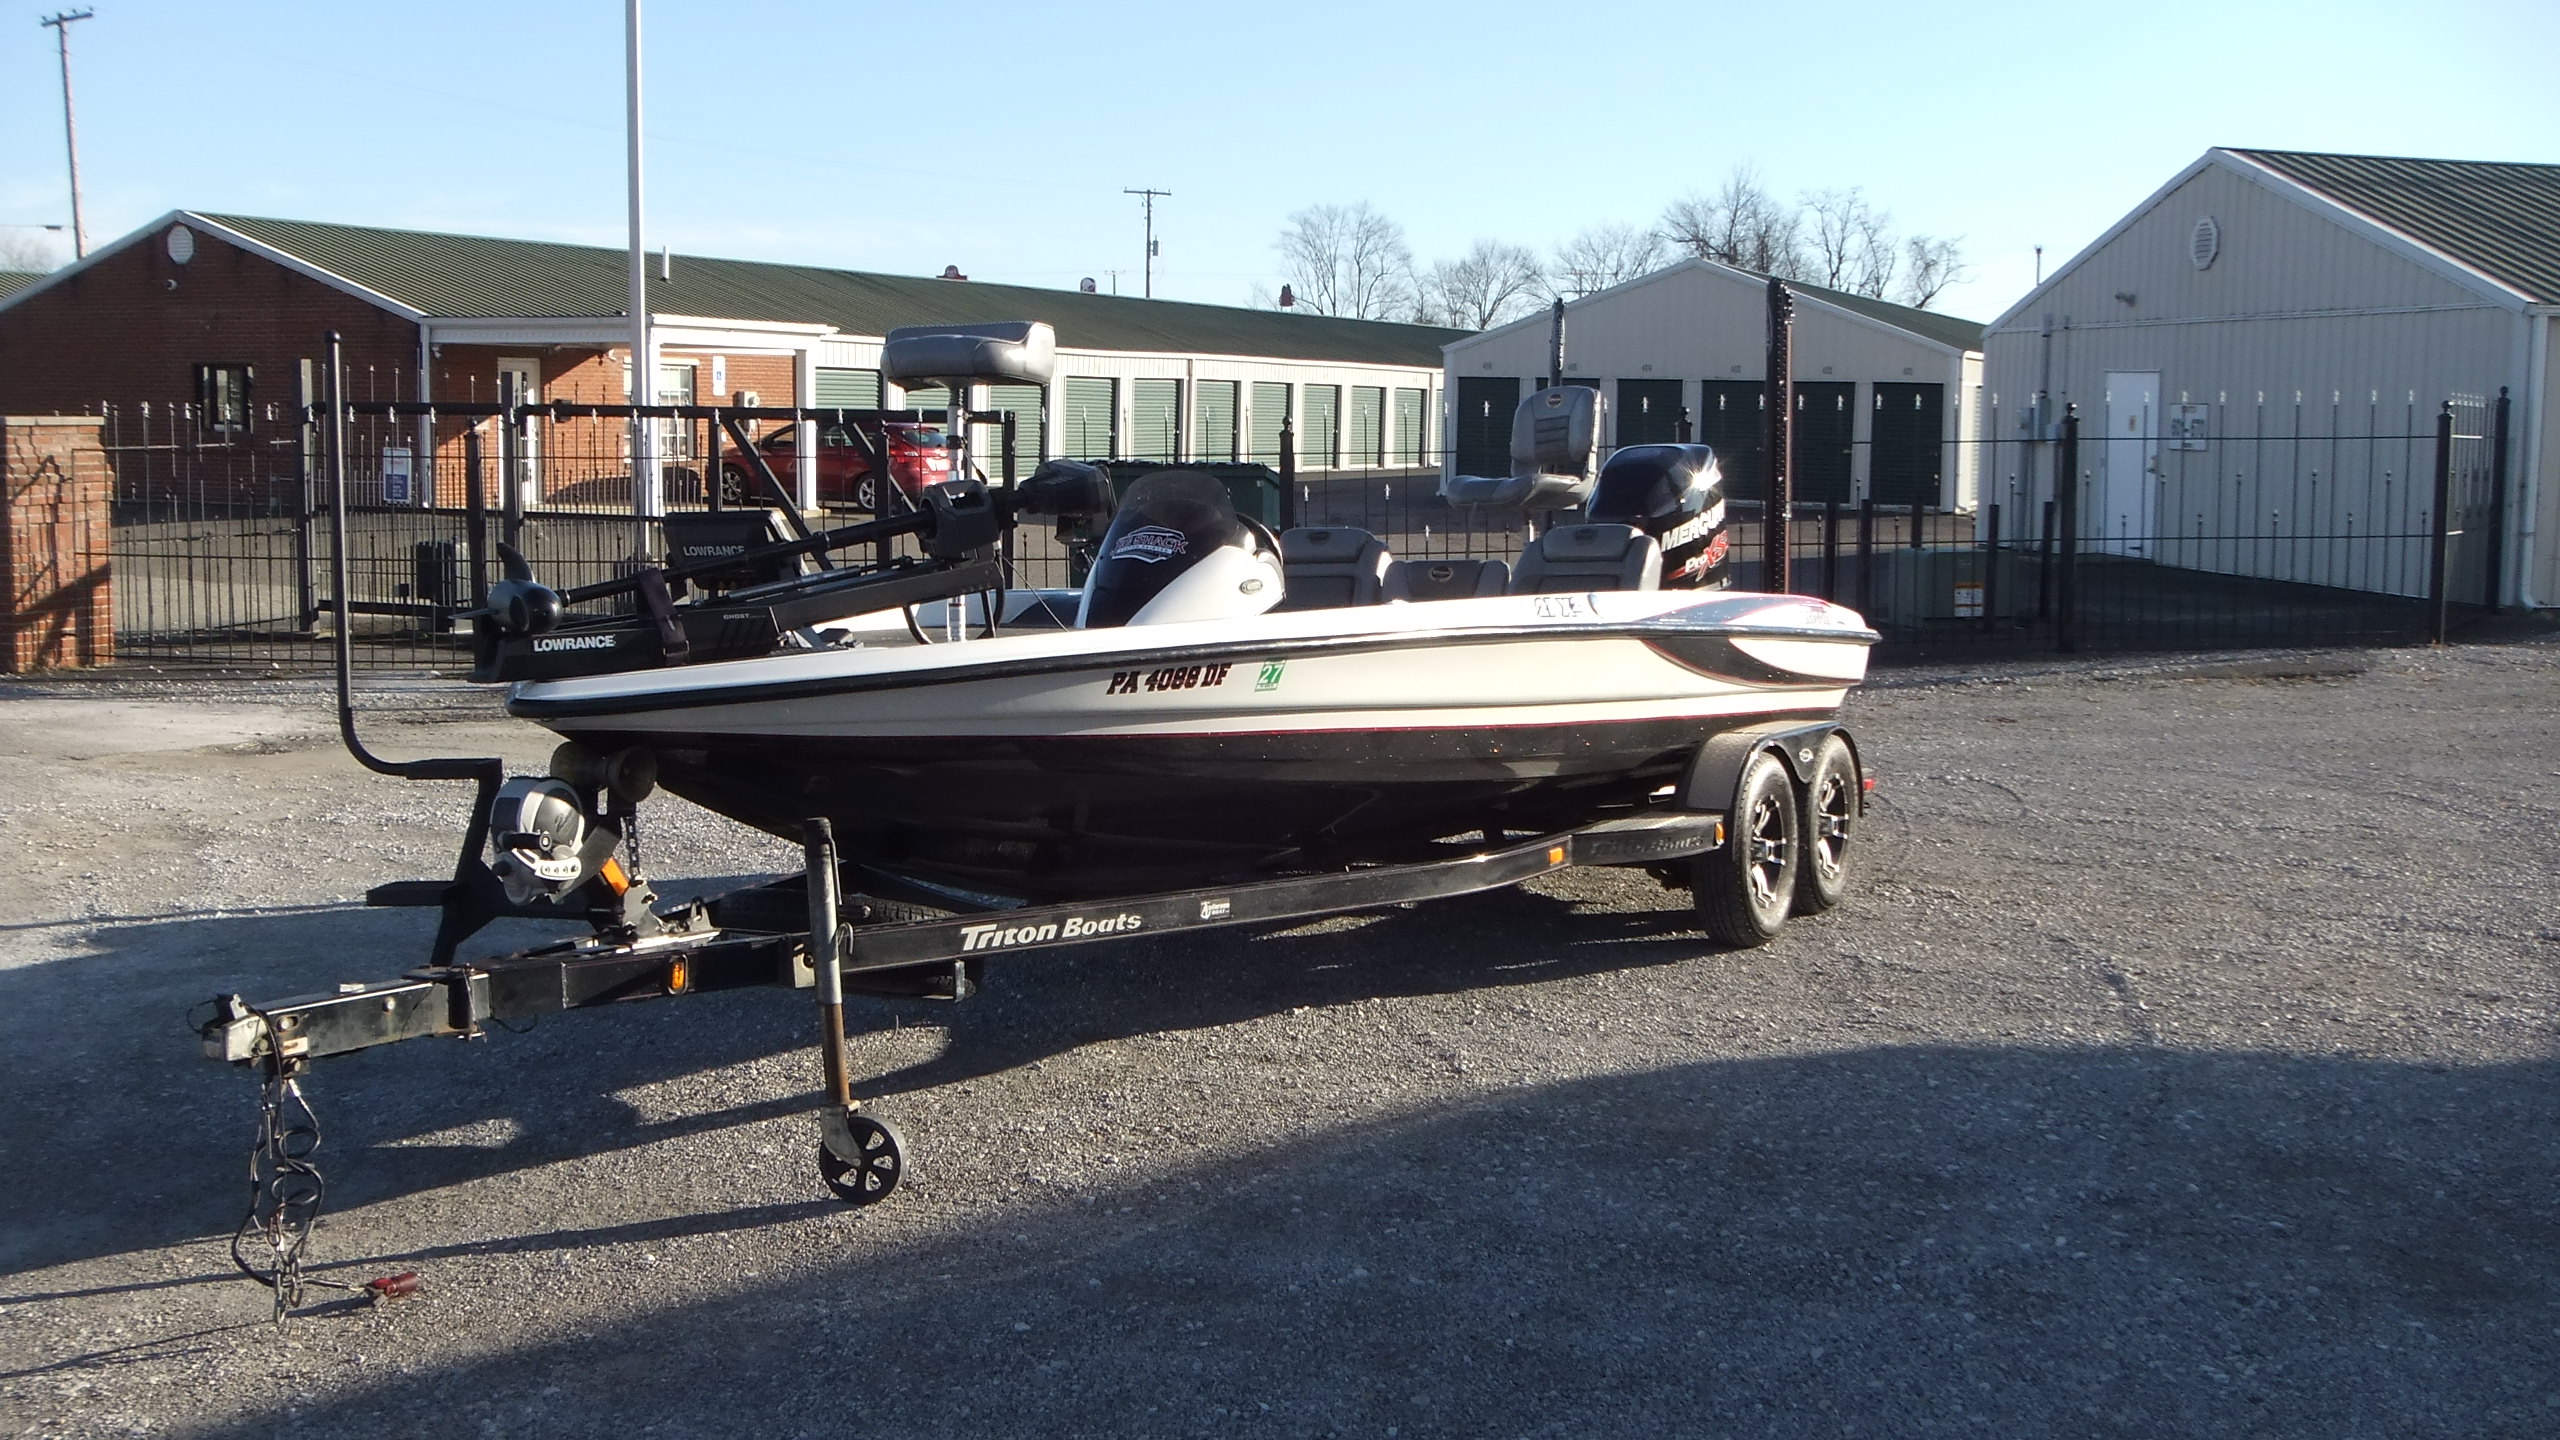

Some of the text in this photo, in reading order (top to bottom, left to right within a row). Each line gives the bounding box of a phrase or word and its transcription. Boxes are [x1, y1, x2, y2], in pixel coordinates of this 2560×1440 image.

[1660, 498, 1725, 553] MERCUR
[683, 545, 745, 556] LOWRANCE
[533, 635, 615, 652] LOWRANCE
[1106, 662, 1233, 695] PA 4088 DF
[1259, 665, 1284, 684] 27
[961, 913, 1142, 951] Triton Boats
